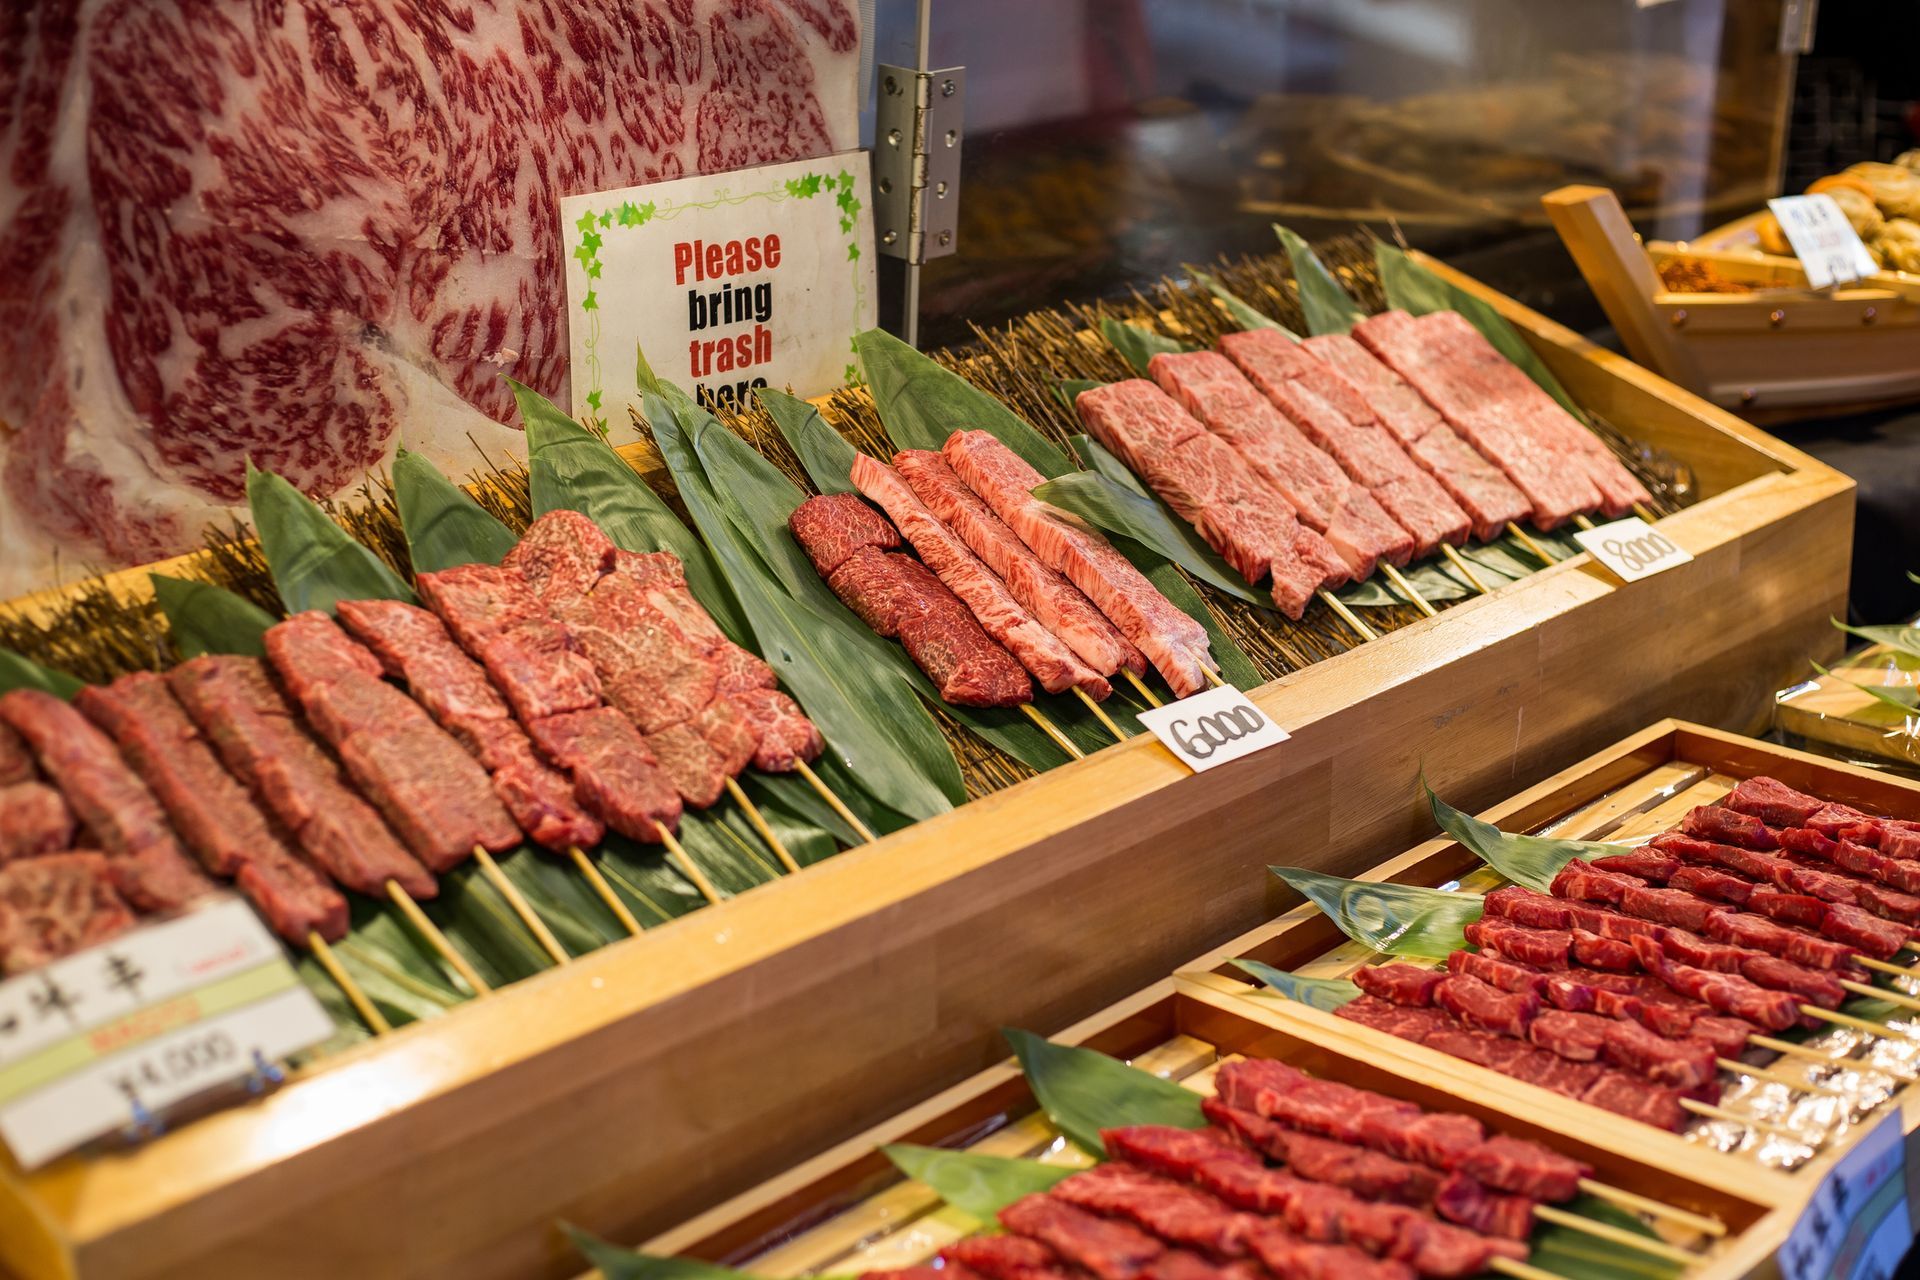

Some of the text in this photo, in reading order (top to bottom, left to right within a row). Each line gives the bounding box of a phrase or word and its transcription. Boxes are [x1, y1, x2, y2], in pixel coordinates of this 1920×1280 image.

[674, 233, 781, 285] Please
[688, 282, 772, 331] bring
[689, 324, 772, 378] trash
[1602, 532, 1677, 572] 8000
[1169, 705, 1265, 759] 6000
